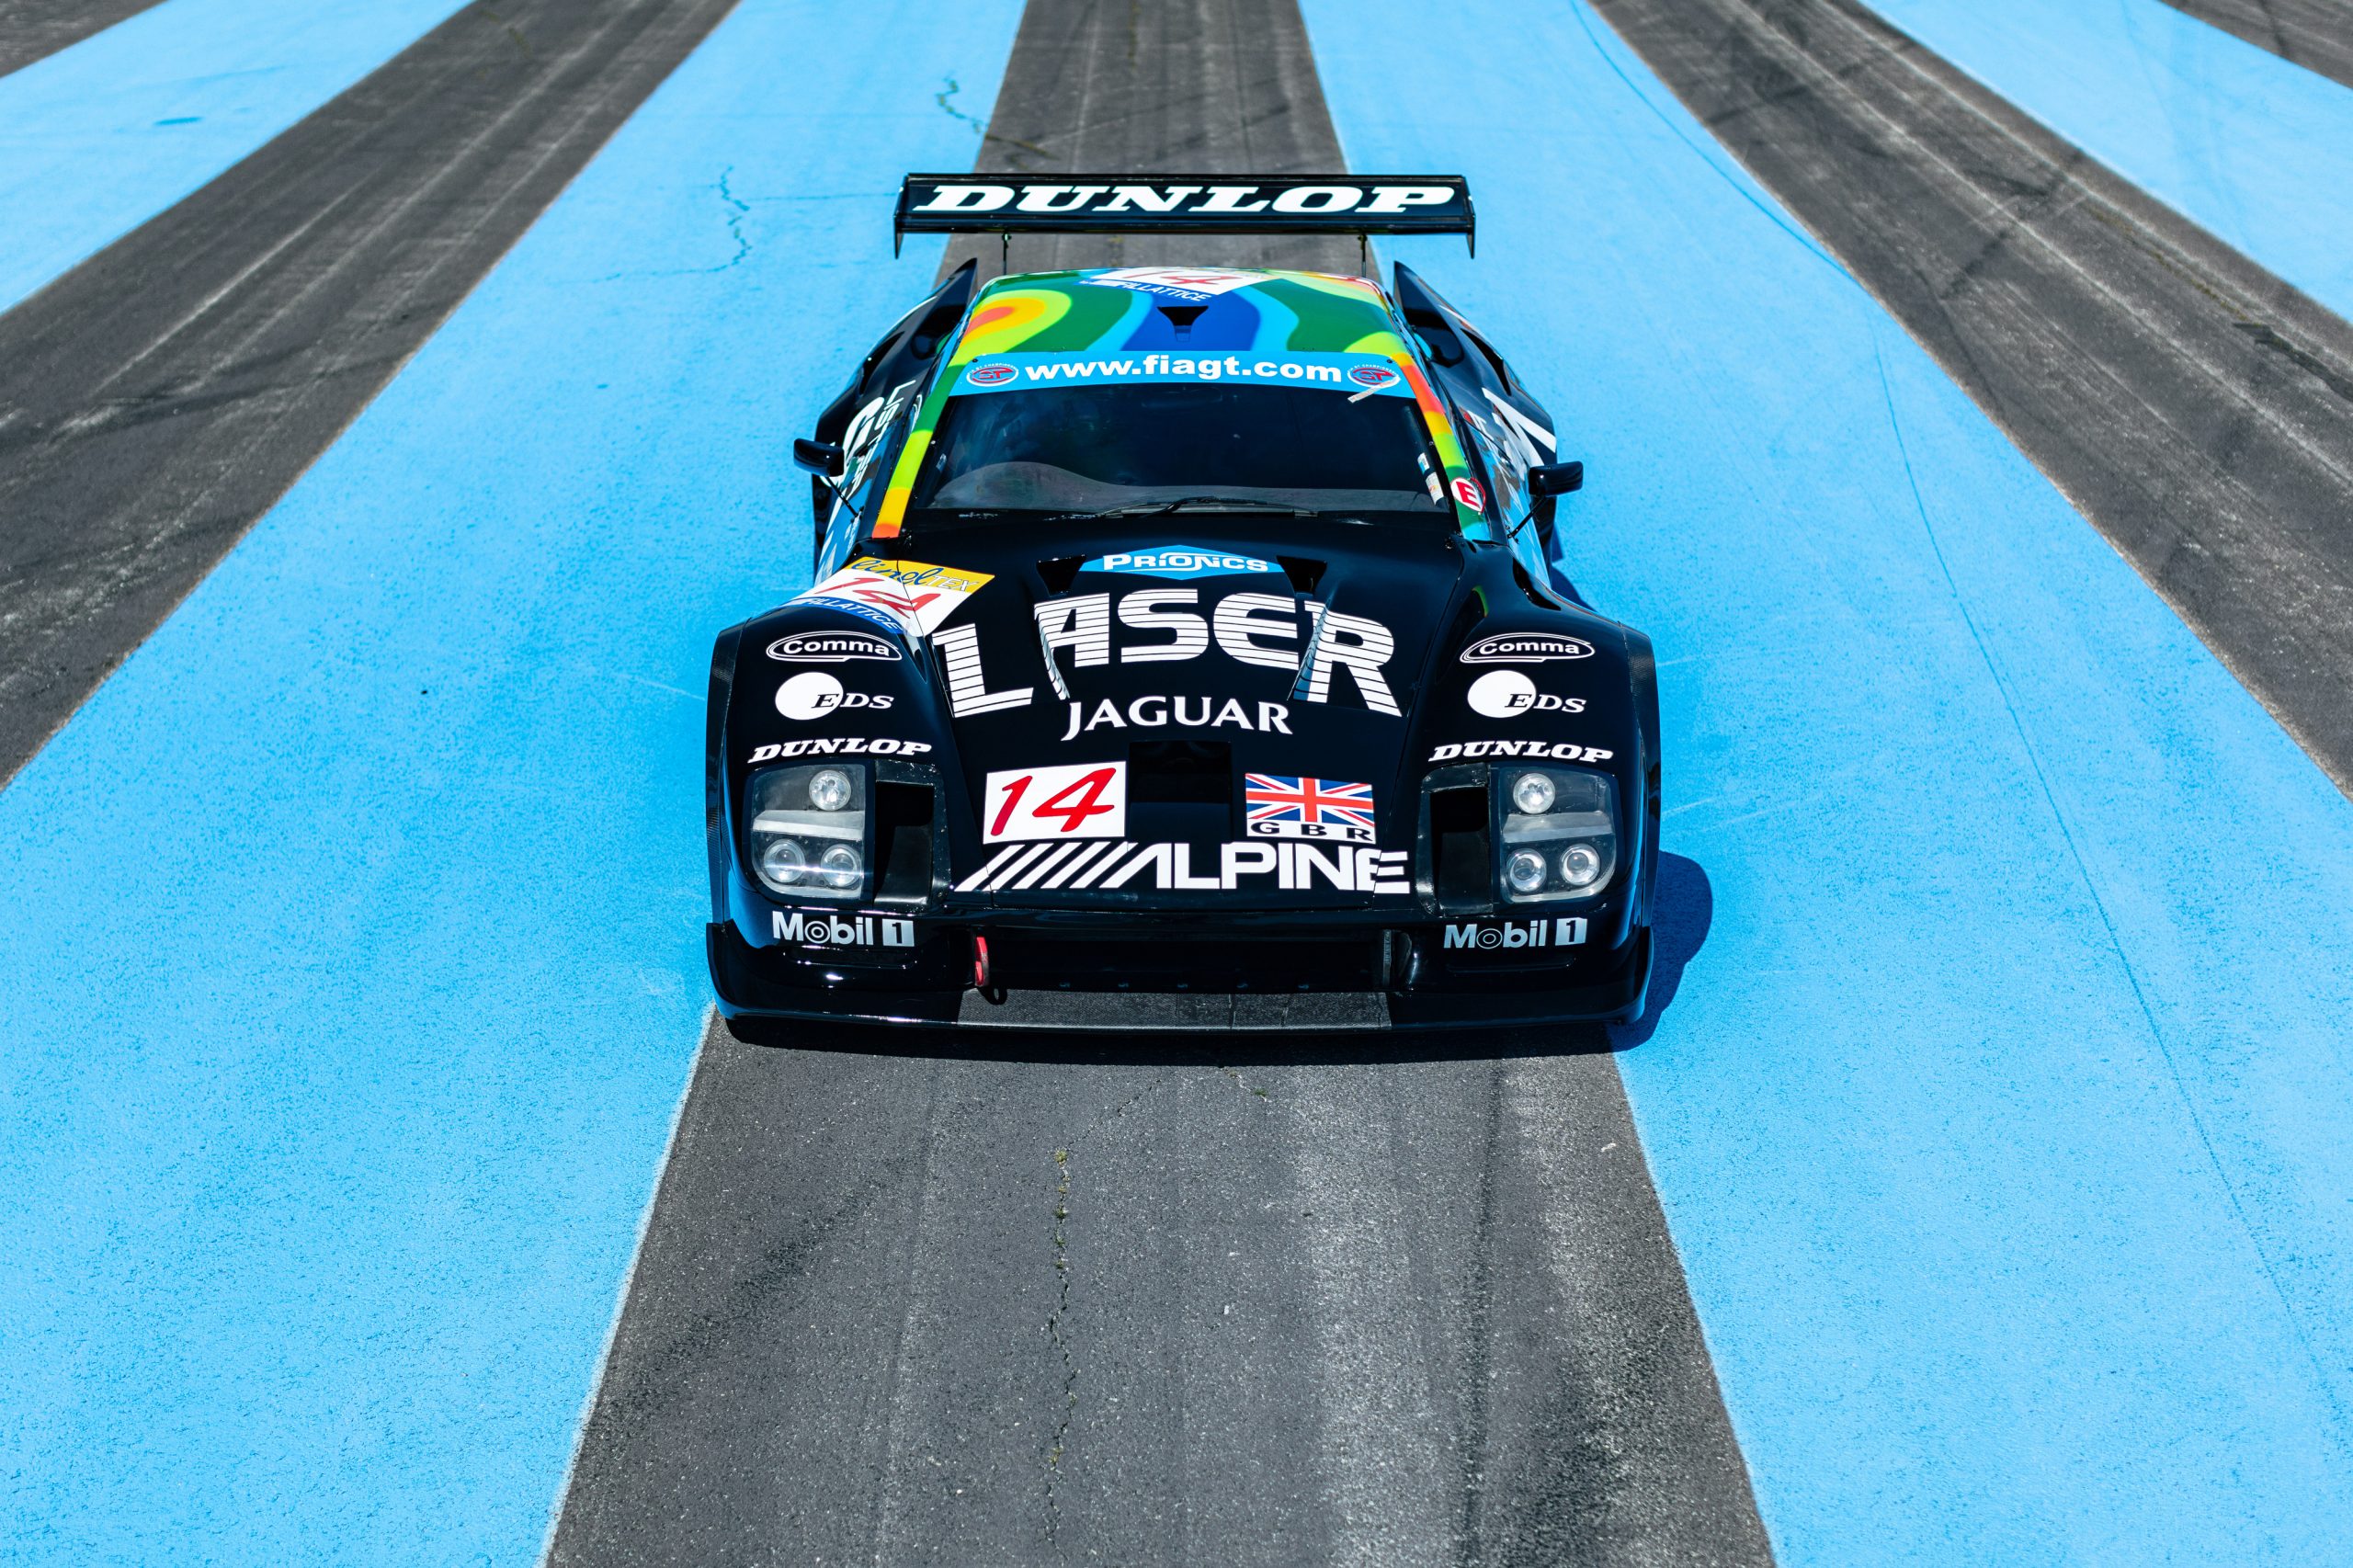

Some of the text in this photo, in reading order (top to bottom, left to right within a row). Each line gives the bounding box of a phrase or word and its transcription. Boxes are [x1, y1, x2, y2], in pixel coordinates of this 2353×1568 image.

[910, 186, 1455, 212] DUNLOP
[1025, 355, 1341, 381] www.fiagt.com
[1455, 481, 1482, 509] E
[783, 639, 890, 656] Comma
[932, 589, 1403, 718] LASER
[1479, 642, 1580, 655] Comma
[811, 692, 894, 710] EDS
[1505, 693, 1587, 713] EDS
[1061, 696, 1292, 742] JAGUAR
[747, 737, 932, 763] DUNLOP
[1427, 740, 1614, 763] DUNLOP
[990, 767, 1116, 835] 14
[1099, 841, 1410, 894] ALPINE
[772, 910, 874, 946] Mobil
[1443, 920, 1548, 949] Mobil
